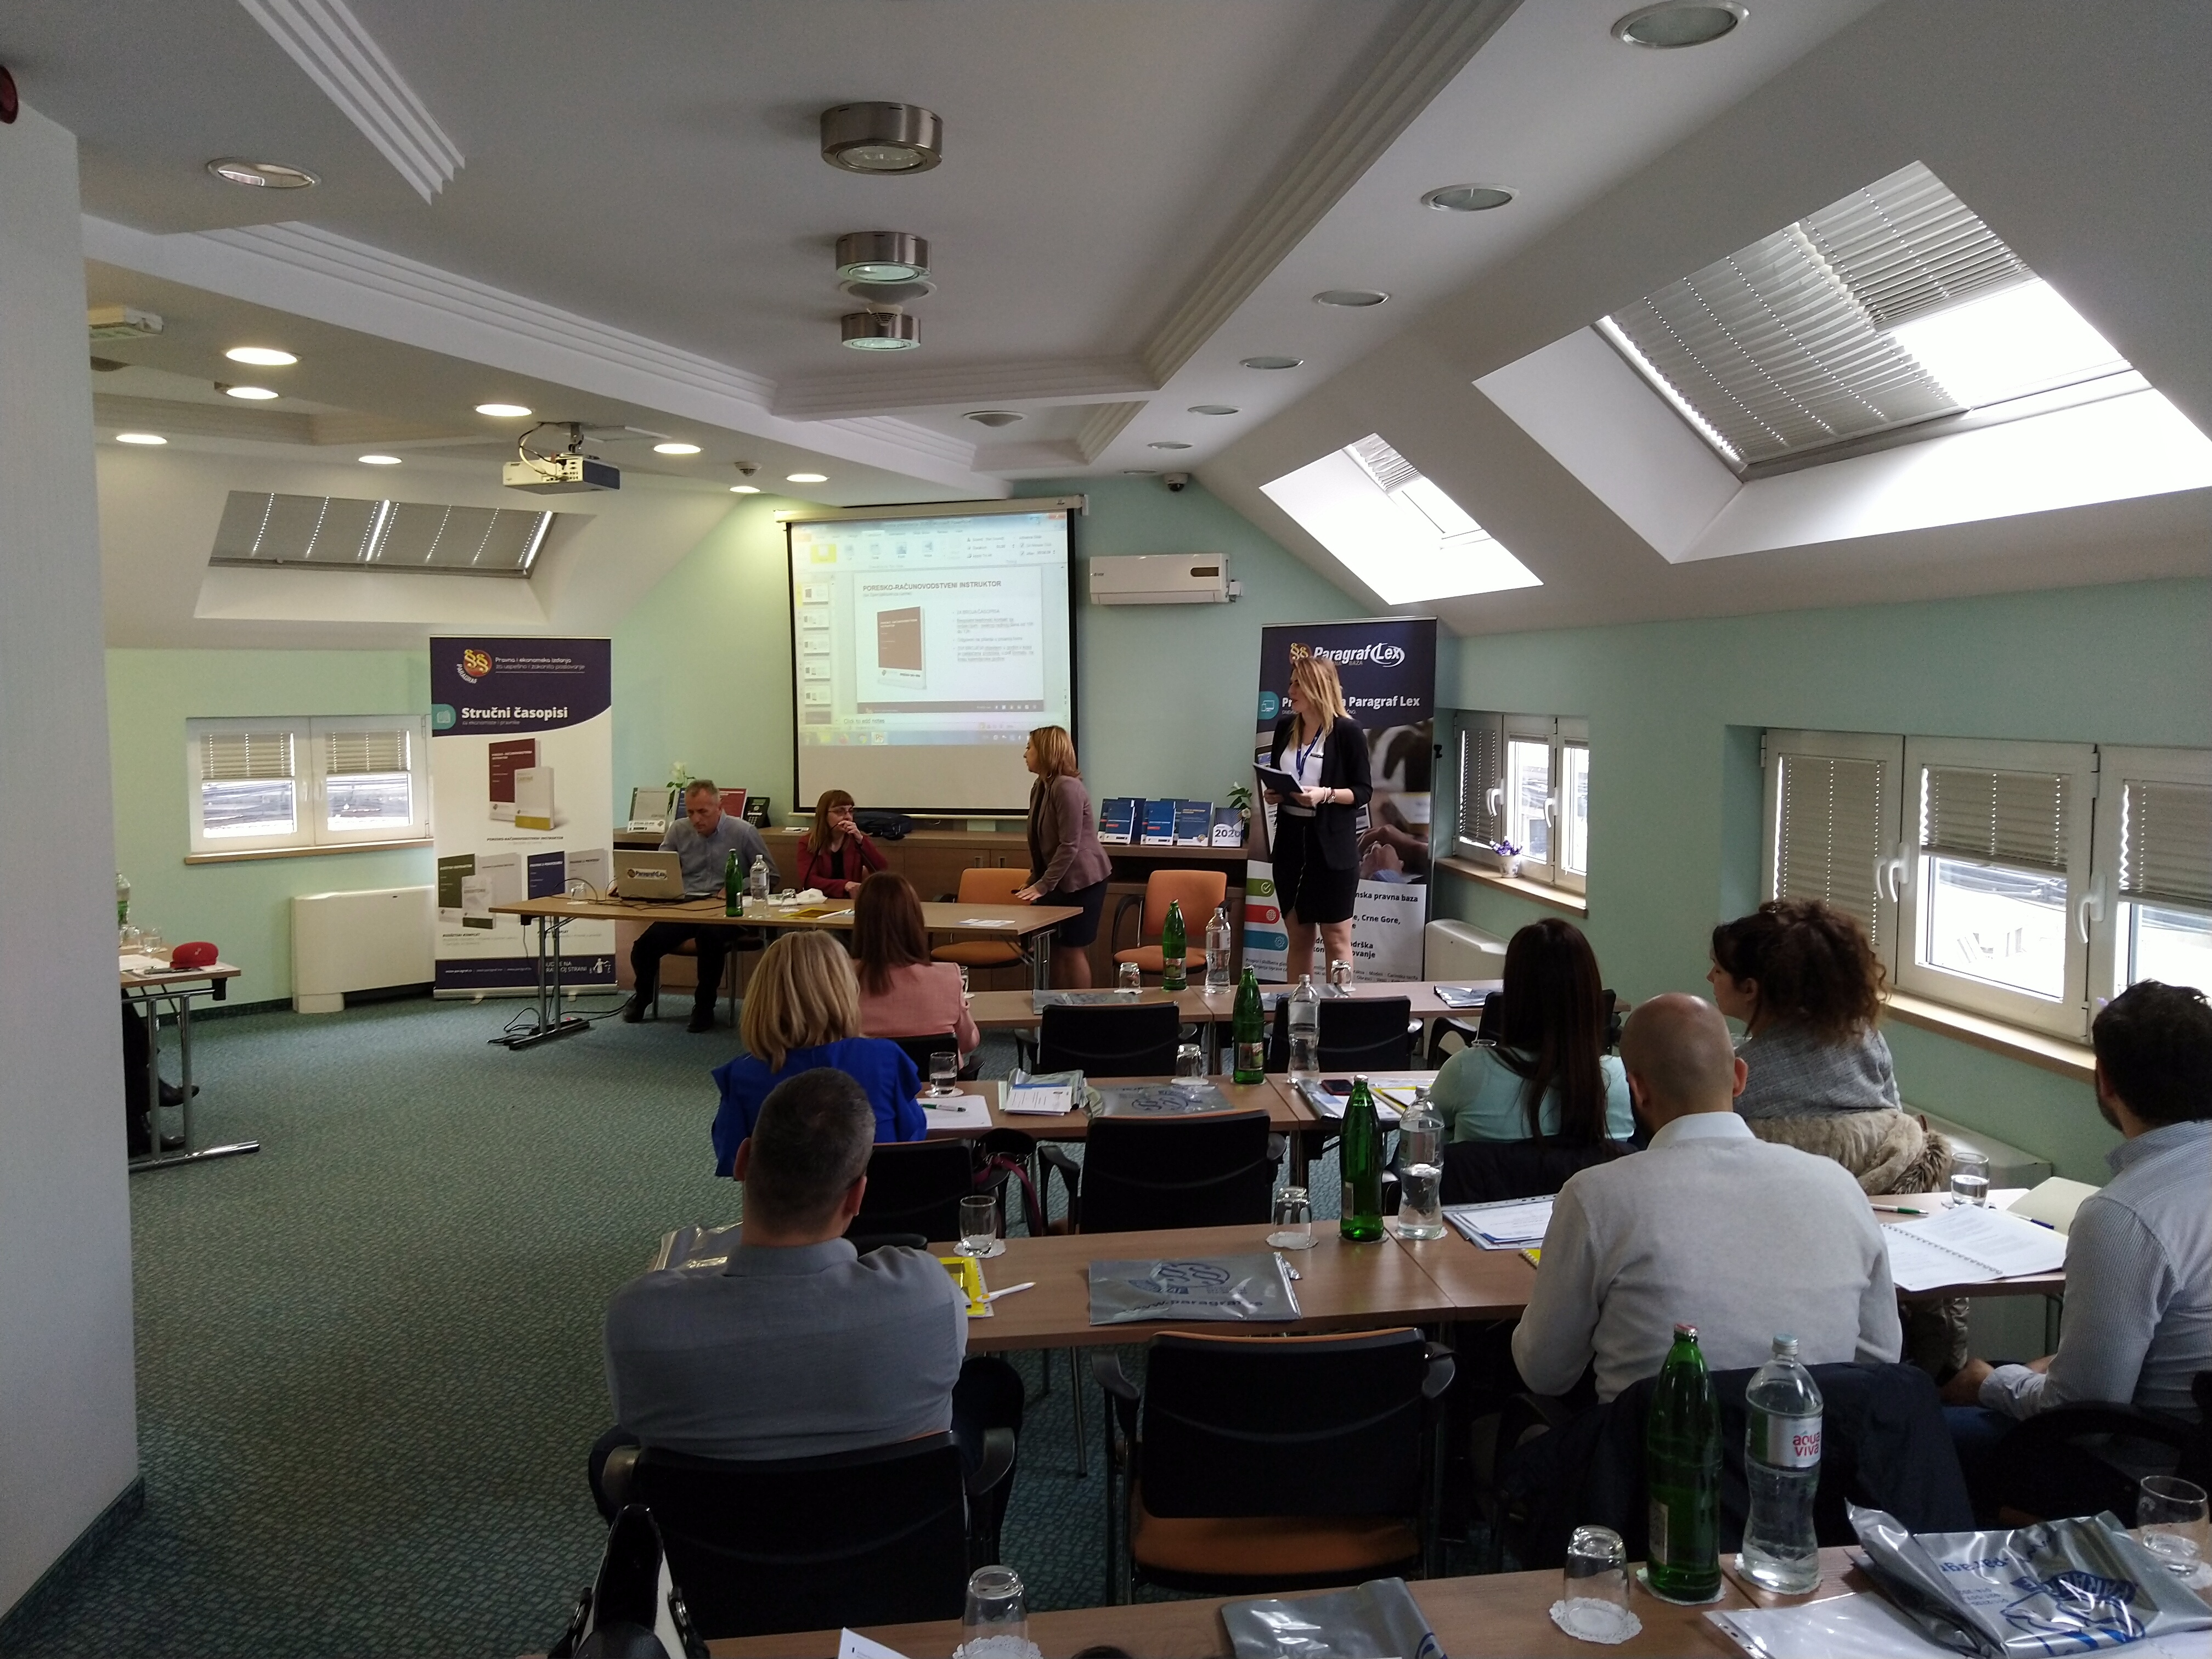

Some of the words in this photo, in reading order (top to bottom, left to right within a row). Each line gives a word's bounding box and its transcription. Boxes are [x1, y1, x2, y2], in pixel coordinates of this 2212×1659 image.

[863, 582, 957, 591] PORESKO-RAČUNOVODSTVENI
[1314, 645, 1372, 664] Paragraf
[1374, 642, 1402, 662] Lex
[1350, 696, 1398, 709] Paragraf
[1400, 696, 1420, 707] Lex
[461, 707, 511, 719] Stručni
[514, 707, 568, 721] časopisi
[1215, 830, 1240, 838] 2020
[1381, 916, 1401, 925] Gore,
